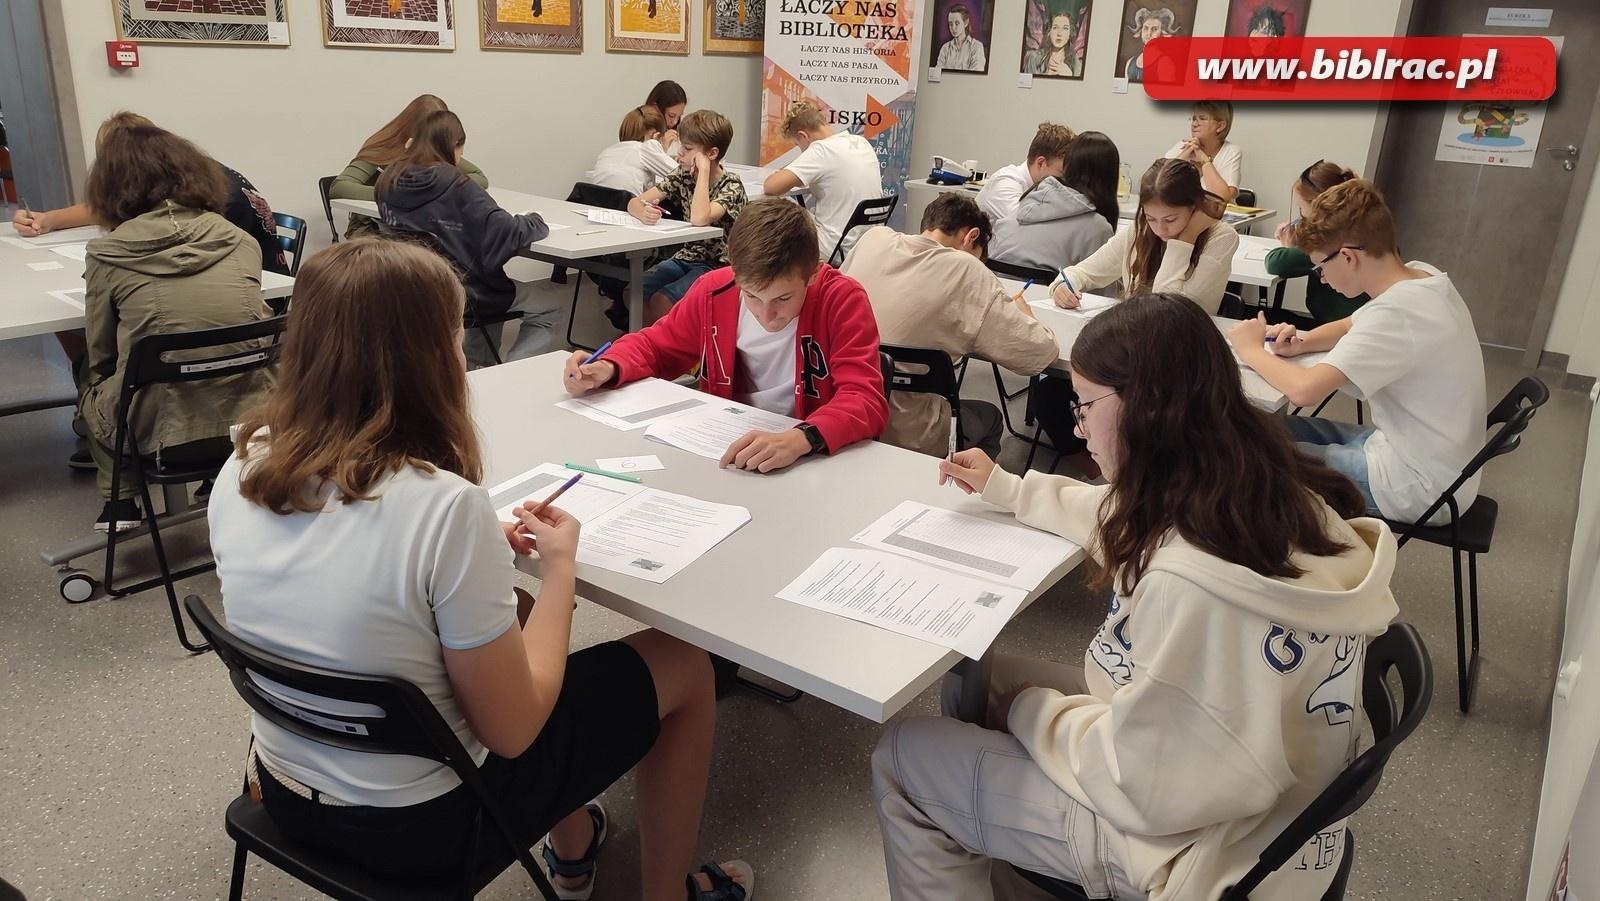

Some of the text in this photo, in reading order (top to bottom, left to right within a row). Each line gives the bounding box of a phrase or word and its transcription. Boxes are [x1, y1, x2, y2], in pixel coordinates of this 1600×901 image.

[780, 0, 897, 18] ŁĄCZY NAS
[779, 20, 909, 42] BIBLIOTEKA
[800, 45, 897, 57] ŁĄCZY NAS HISTORIA
[799, 59, 879, 70] ŁĄCZY NAS PASJA
[799, 74, 900, 86] ŁĄCZY NAS PRZYRODA
[817, 109, 882, 127] ISKO
